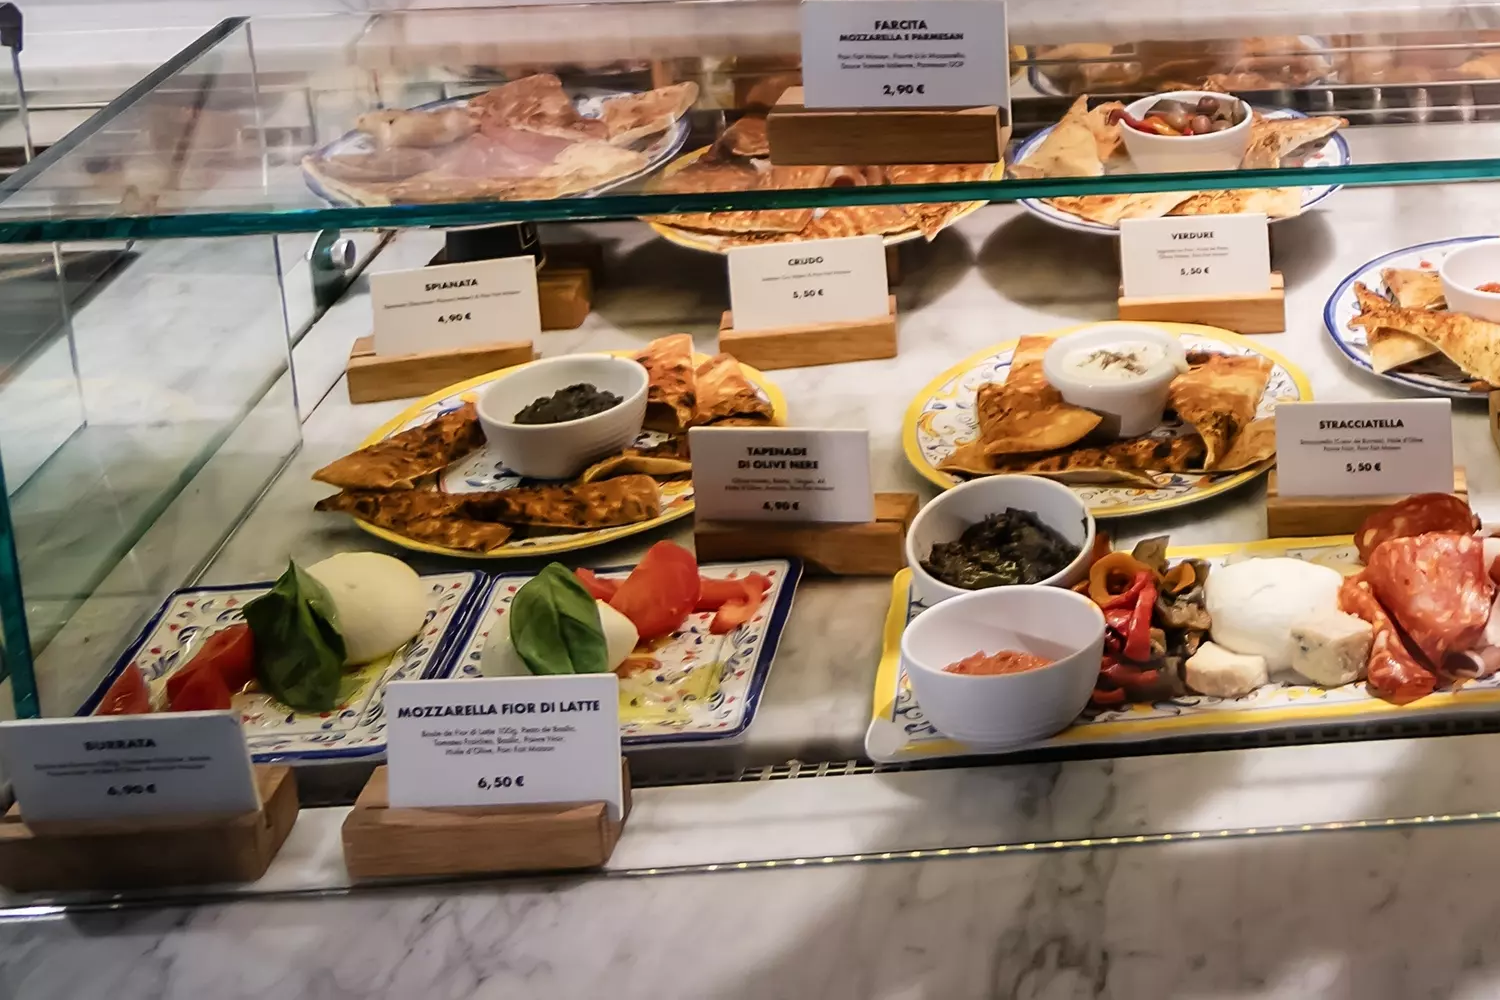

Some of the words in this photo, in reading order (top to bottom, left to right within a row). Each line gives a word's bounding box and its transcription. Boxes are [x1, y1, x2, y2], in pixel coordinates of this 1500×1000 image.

[875, 20, 928, 30] FARCITA
[840, 34, 902, 42] MOZZARELLA
[1171, 231, 1214, 240] VERDURE
[788, 256, 824, 266] CRUDO
[425, 278, 479, 292] SPIANATA
[1319, 419, 1404, 430] STRACCIATELLA
[747, 447, 807, 456] TAPENADE
[753, 460, 787, 469] OLIVE
[790, 460, 819, 469] NERE
[398, 704, 497, 719] MOZZARELLA
[502, 703, 535, 714] FIOR
[560, 700, 600, 712] LATTE
[84, 738, 156, 751] BURRATA
